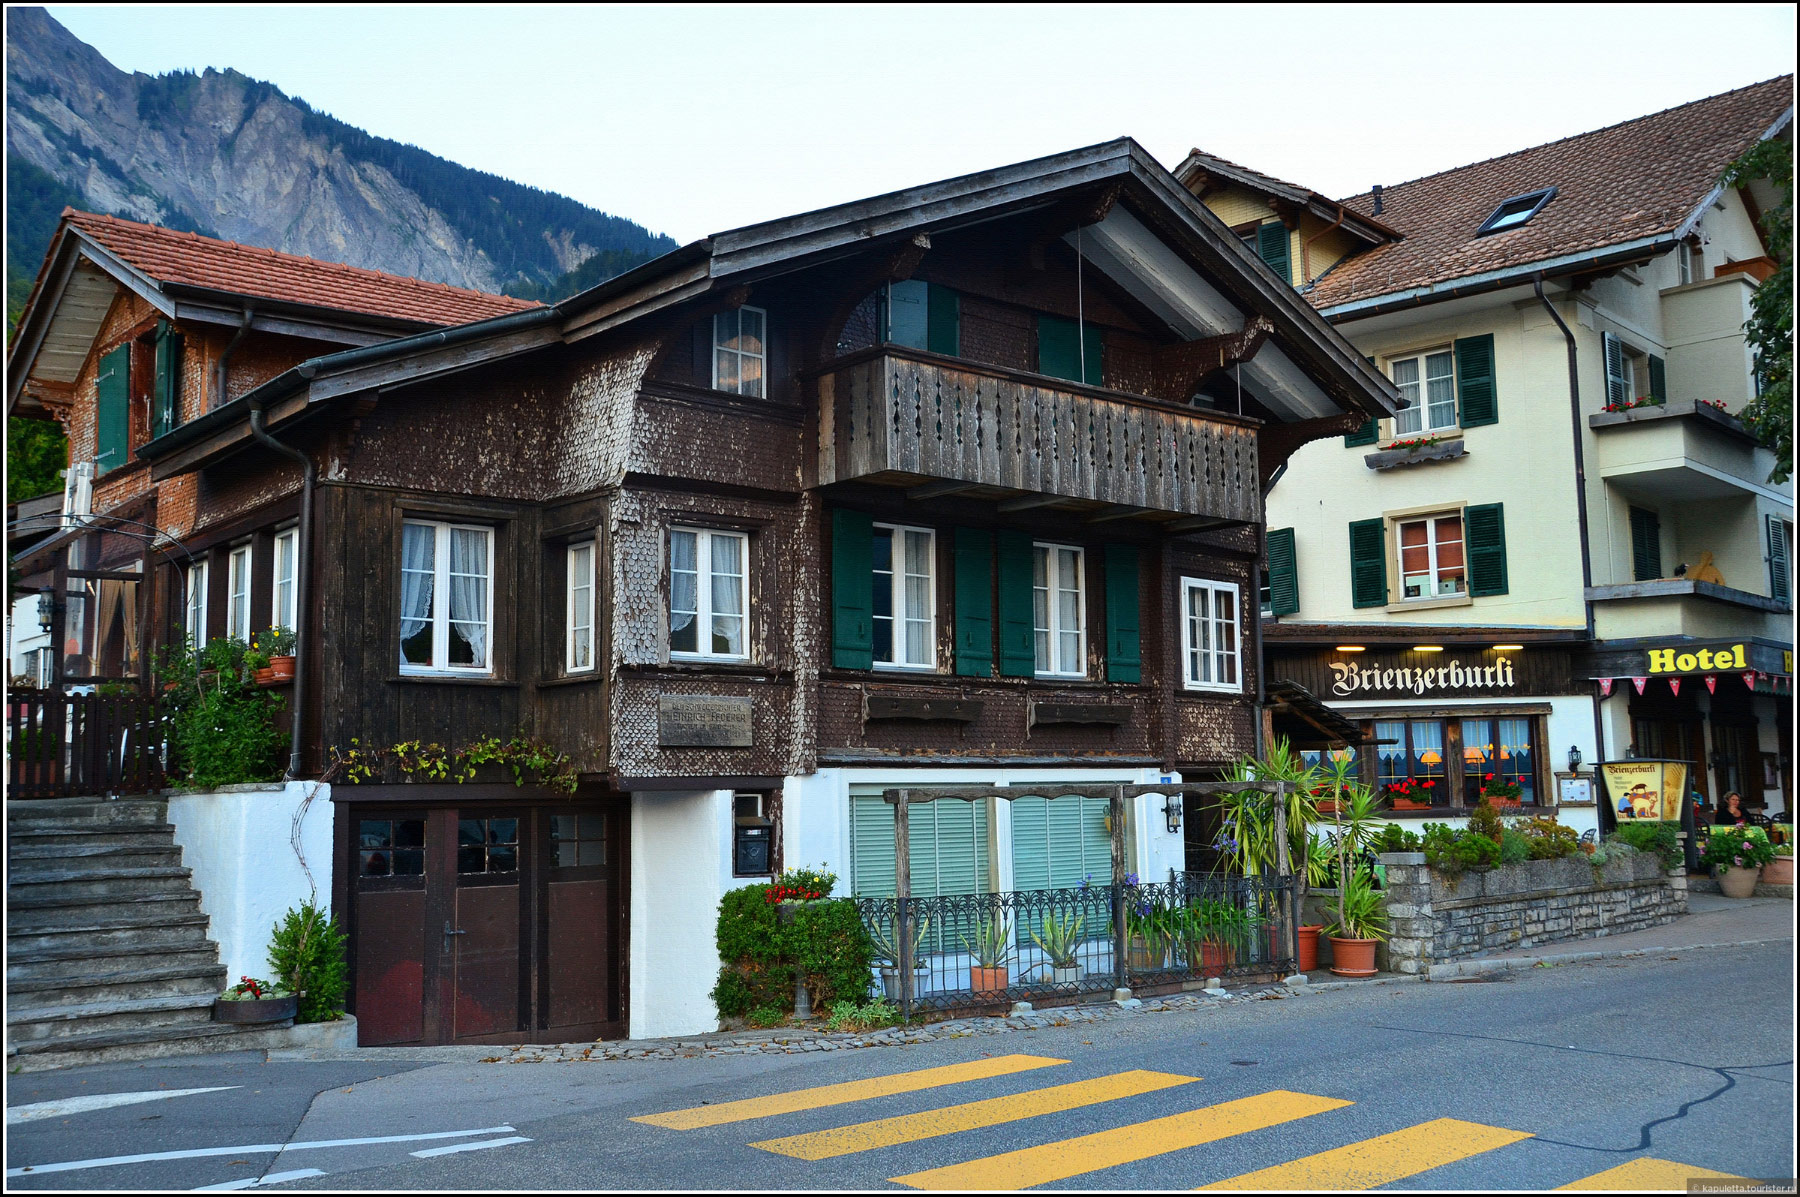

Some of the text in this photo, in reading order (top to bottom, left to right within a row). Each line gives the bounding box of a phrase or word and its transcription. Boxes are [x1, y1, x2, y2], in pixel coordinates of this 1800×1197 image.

[1648, 644, 1747, 673] Hotel
[1328, 656, 1515, 697] Brienzerburli
[666, 711, 746, 722] HEINRICH FEDERER
